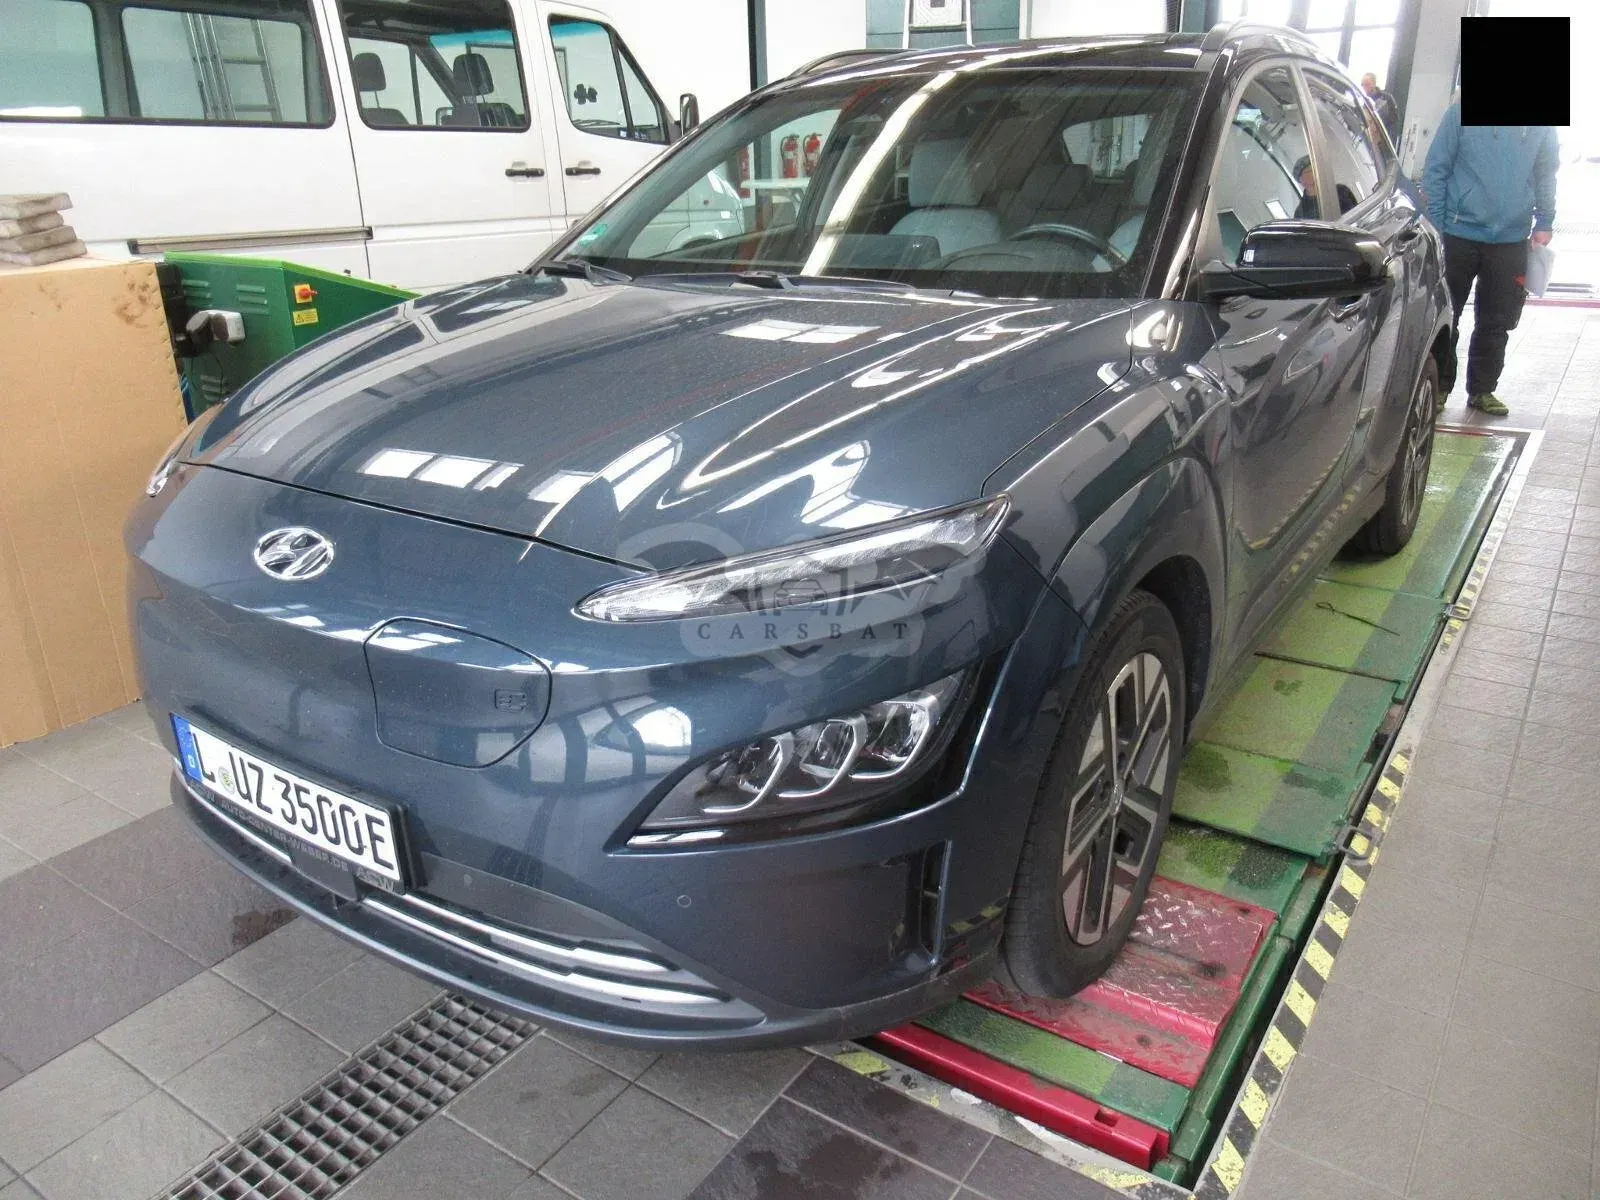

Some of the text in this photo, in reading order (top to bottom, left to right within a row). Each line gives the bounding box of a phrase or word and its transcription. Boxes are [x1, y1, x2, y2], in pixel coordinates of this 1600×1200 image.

[188, 731, 395, 871] L UZ 3500E
